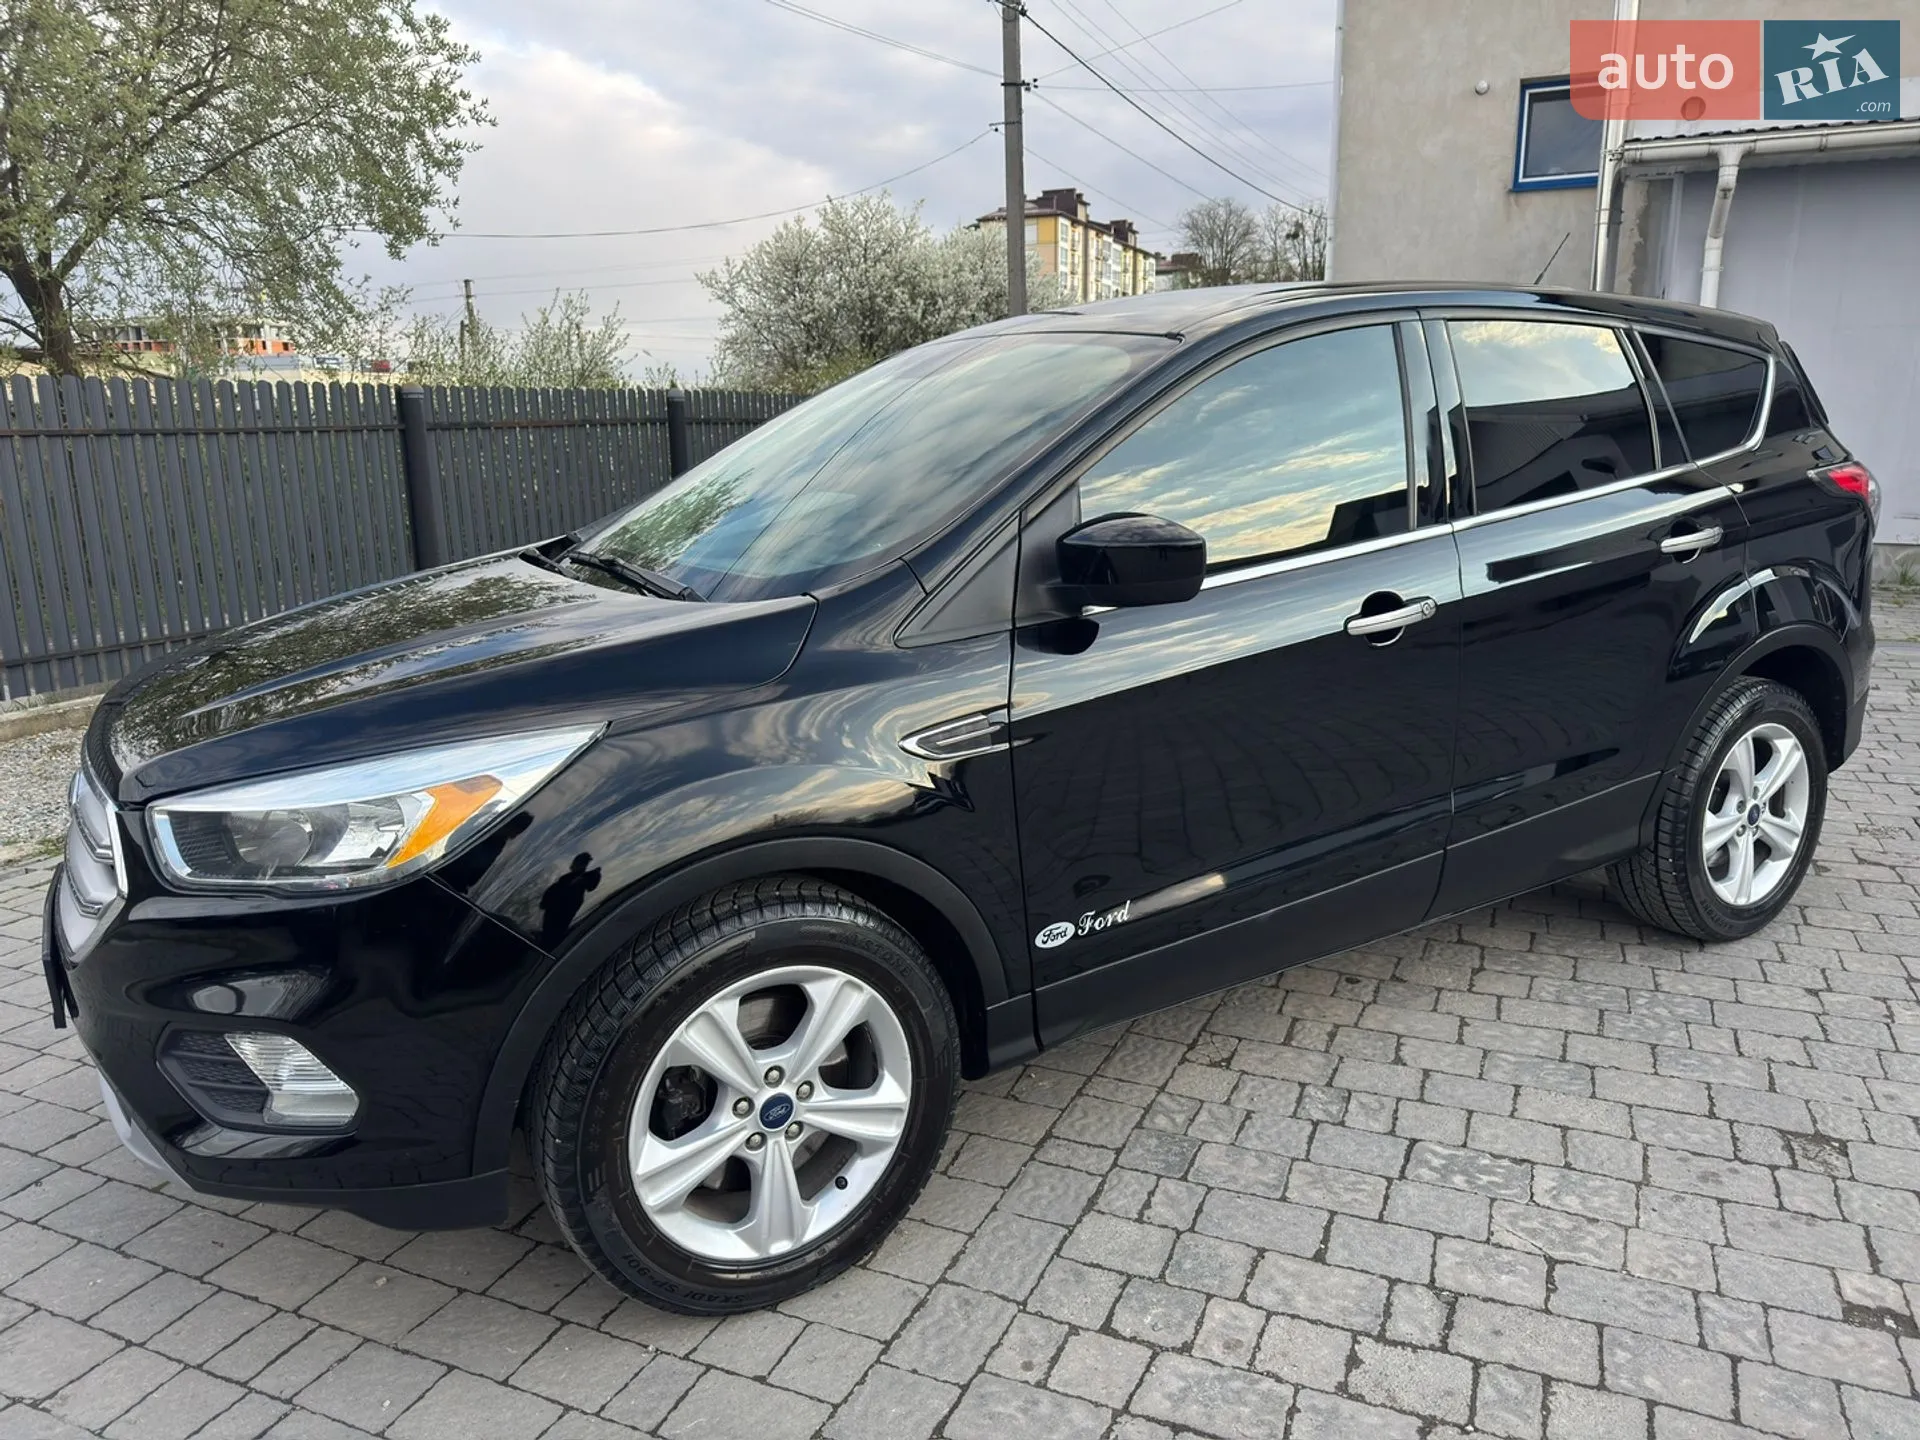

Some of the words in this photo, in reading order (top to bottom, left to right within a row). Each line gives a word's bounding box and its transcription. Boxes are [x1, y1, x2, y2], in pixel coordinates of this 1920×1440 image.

[1041, 925, 1069, 945] Ford
[1077, 900, 1130, 936] Ford
[620, 1253, 680, 1294] SP-901
[682, 1289, 745, 1304] SKADI
